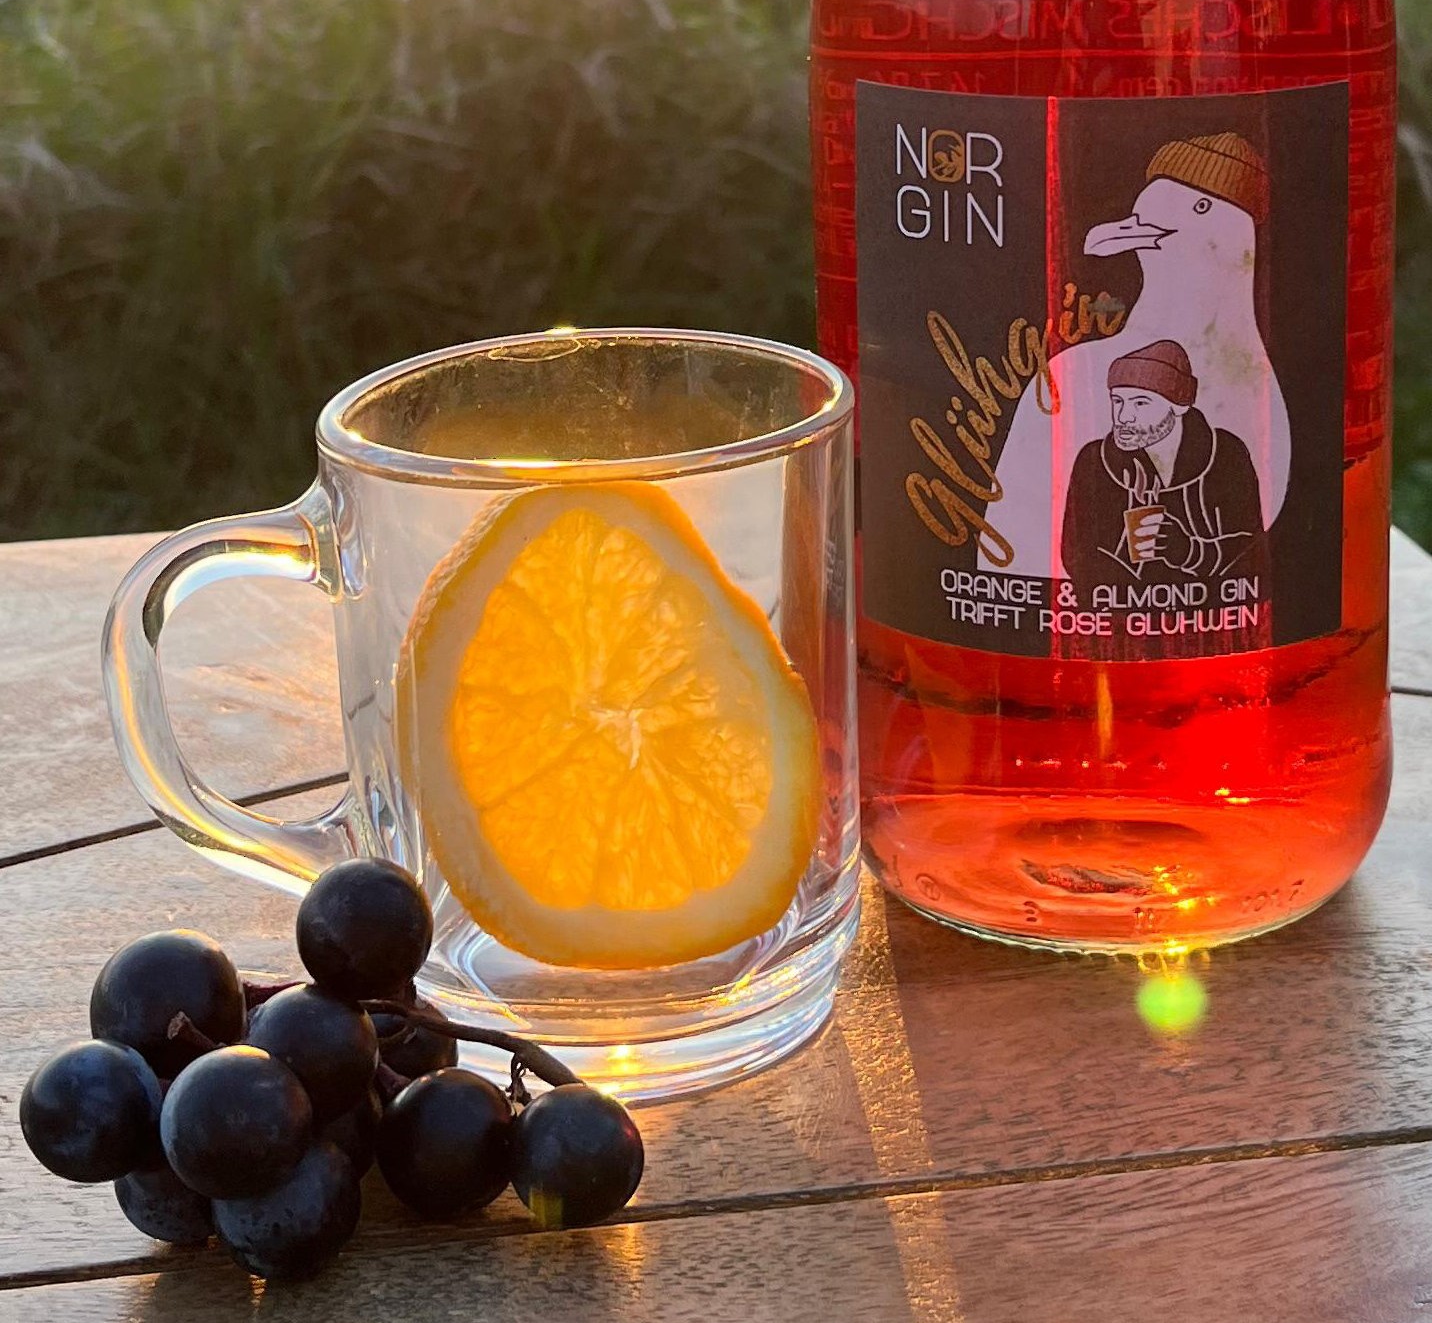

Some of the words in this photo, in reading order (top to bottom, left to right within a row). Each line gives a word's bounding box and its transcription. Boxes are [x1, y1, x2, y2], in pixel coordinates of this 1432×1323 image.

[896, 184, 1004, 248] GIN
[940, 568, 1043, 605] ORANGE
[1056, 582, 1078, 608] &
[1092, 582, 1208, 609] ALMOND
[1219, 576, 1259, 603] GIN
[945, 596, 1026, 630] TRIFFT
[1039, 606, 1113, 636] ROSÉ
[1125, 603, 1259, 637] GLÜHWEIN
